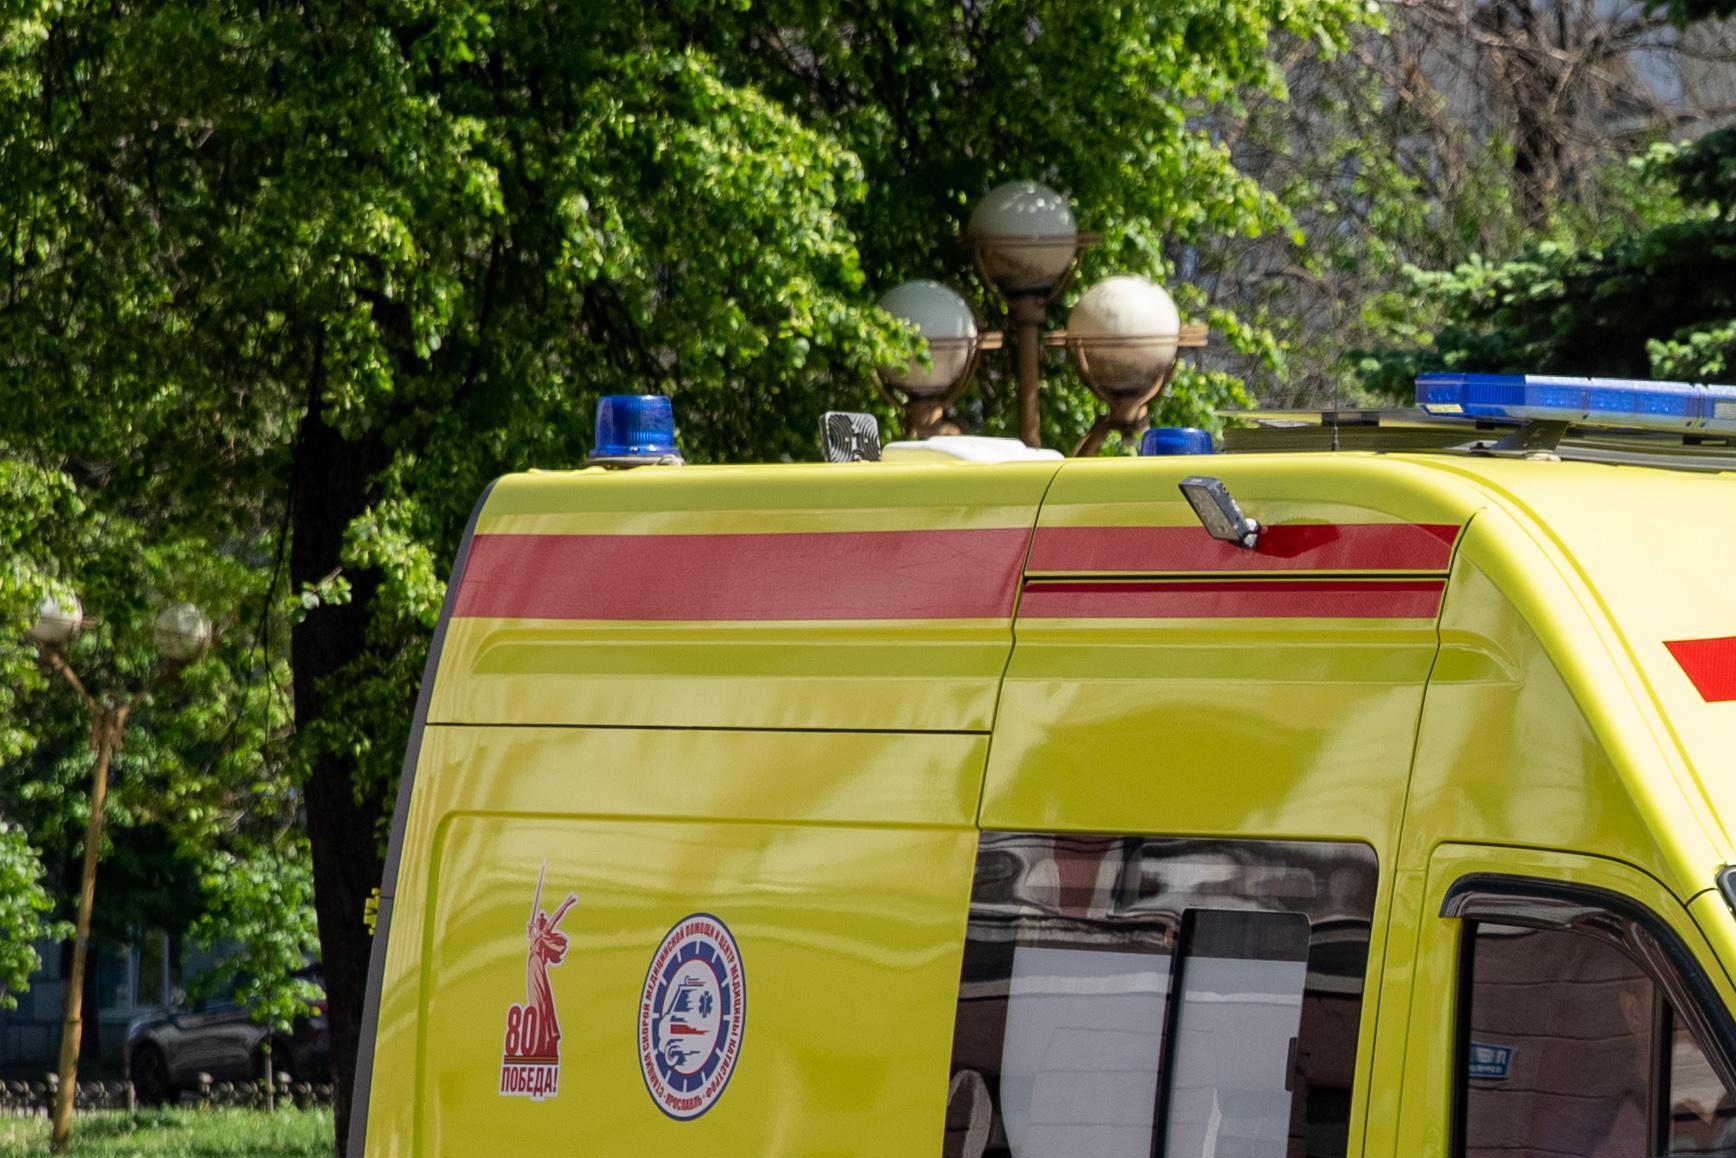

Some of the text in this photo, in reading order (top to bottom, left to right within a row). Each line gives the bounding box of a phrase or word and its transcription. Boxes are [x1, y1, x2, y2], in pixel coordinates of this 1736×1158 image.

[505, 1005, 538, 1056] 80
[641, 1003, 650, 1052] СКОРОЙ
[501, 1066, 558, 1097] ПОБЕДА!
